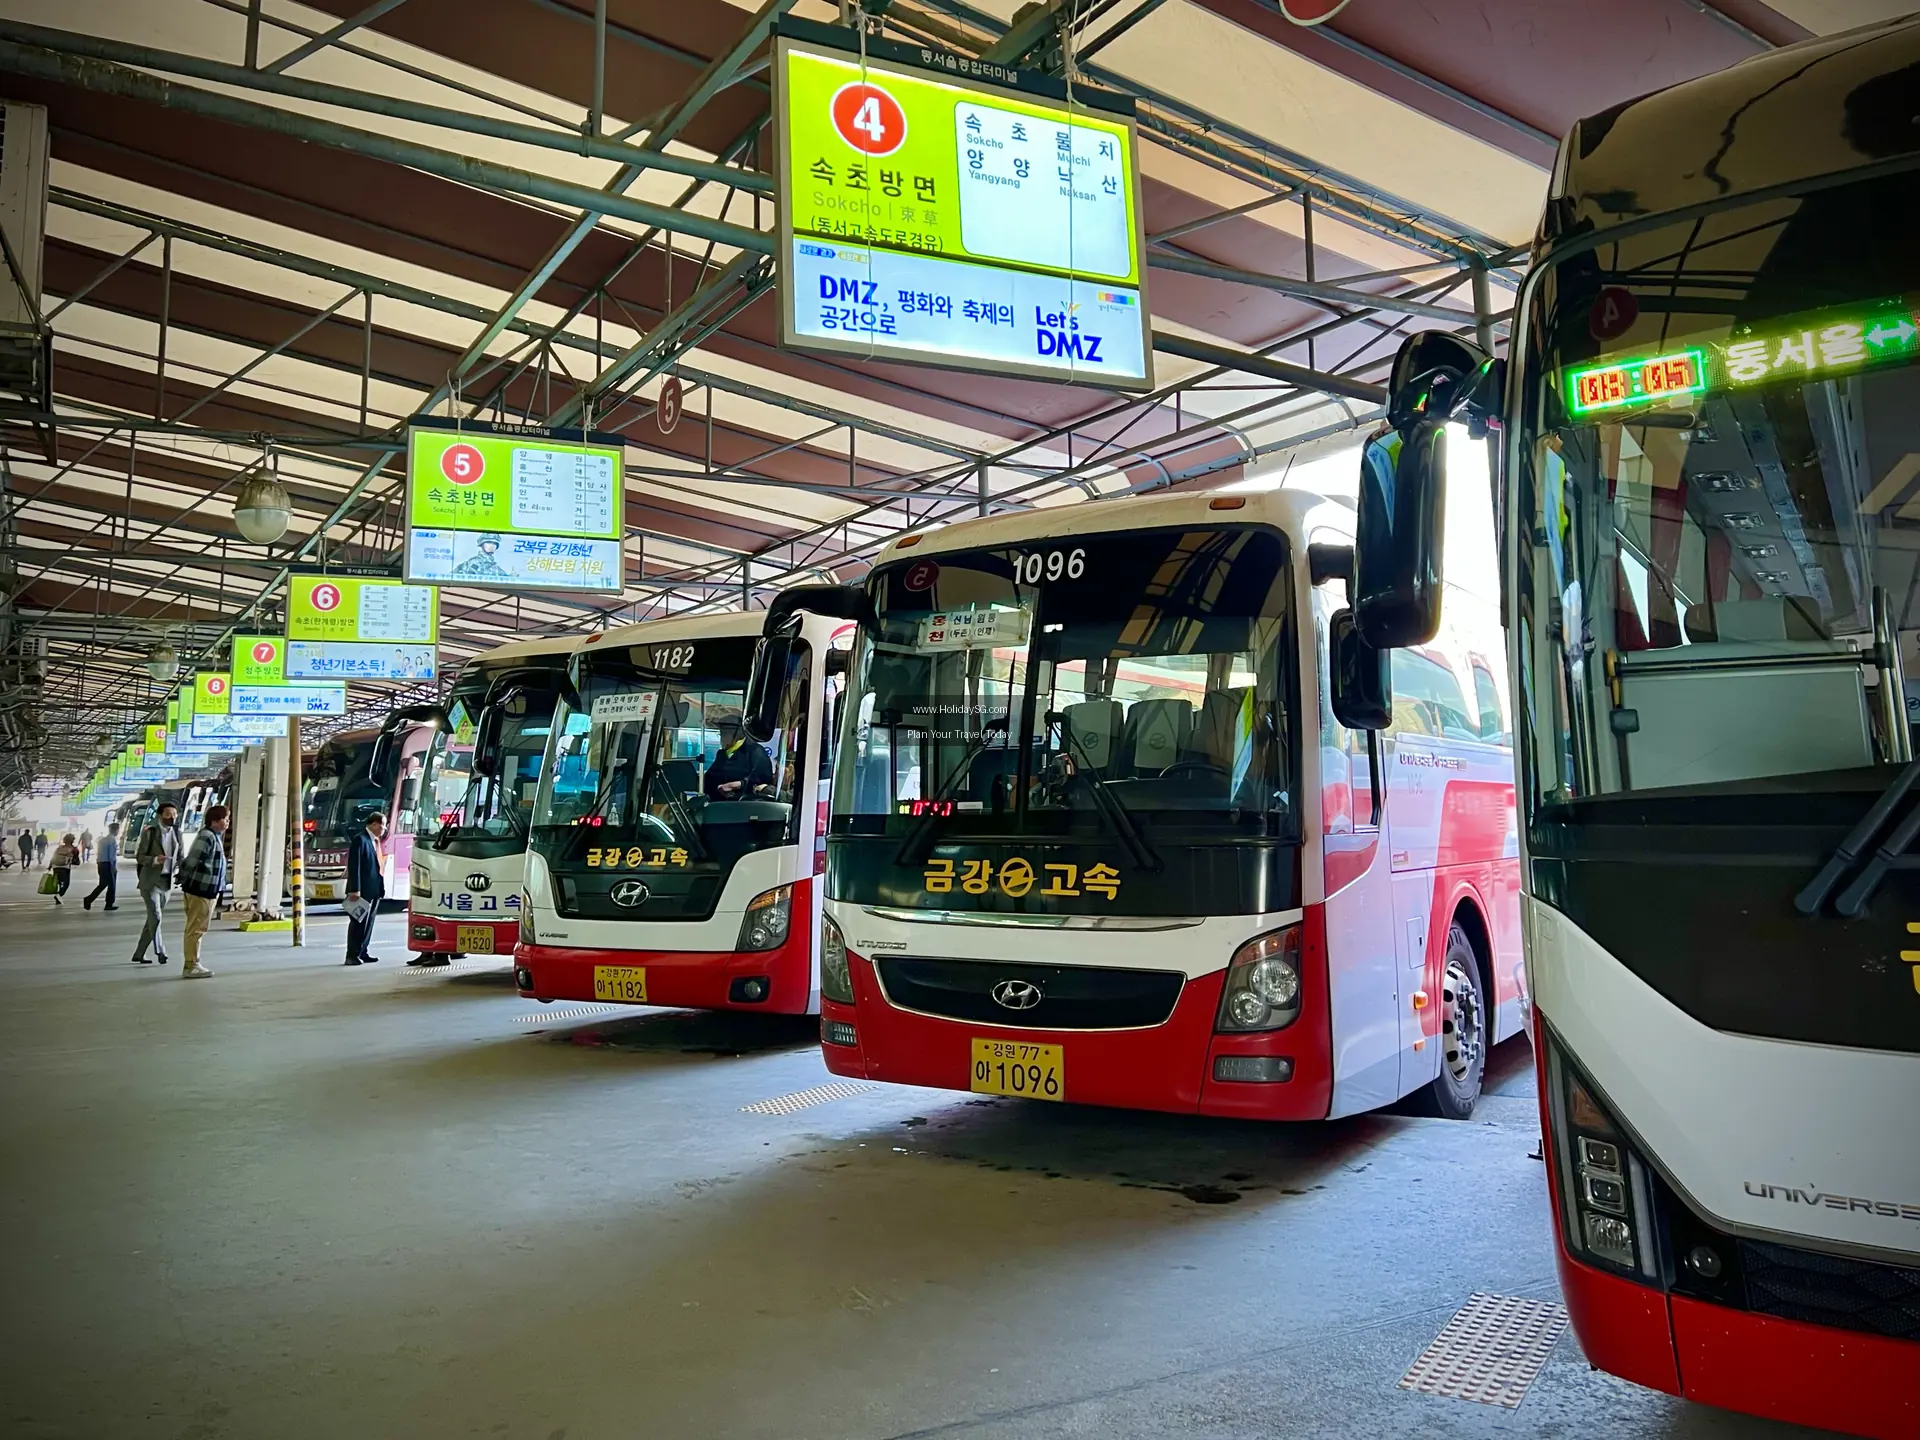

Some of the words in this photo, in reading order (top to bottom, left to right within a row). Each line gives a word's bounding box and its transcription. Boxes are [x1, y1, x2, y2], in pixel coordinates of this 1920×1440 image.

[921, 49, 1018, 83] 동서울종합터미널
[853, 96, 886, 142] 4
[966, 133, 1004, 149] Sokcho
[1057, 151, 1091, 167] Mulchi
[968, 168, 1021, 189] Yangyang
[813, 191, 882, 217] Sokcho
[1059, 185, 1097, 202] Naksan
[820, 305, 897, 335] 공간으로
[898, 290, 953, 319] 평화와
[962, 299, 1015, 328] 축제의
[1036, 328, 1103, 362] DMZ
[1725, 324, 1865, 381] 동서울
[664, 387, 674, 424] 5
[453, 452, 472, 476] 5
[513, 540, 549, 555] 군복무
[549, 542, 593, 557] 경기청년
[526, 557, 577, 574] 상해보험
[578, 560, 604, 575] 지원
[1013, 549, 1086, 585] 1096
[317, 586, 334, 609] 6
[259, 646, 270, 659] 7
[654, 645, 695, 669] 1182
[310, 658, 386, 672] 청년기본소득!
[212, 680, 221, 692] 8
[307, 703, 330, 711] DMZ
[586, 848, 621, 867] 금강
[648, 847, 689, 867] 고속
[467, 876, 486, 889] KIA
[924, 859, 994, 894] 금강
[1040, 862, 1121, 901] 고속
[993, 1043, 1015, 1059] 강원
[1020, 1045, 1040, 1060] 77
